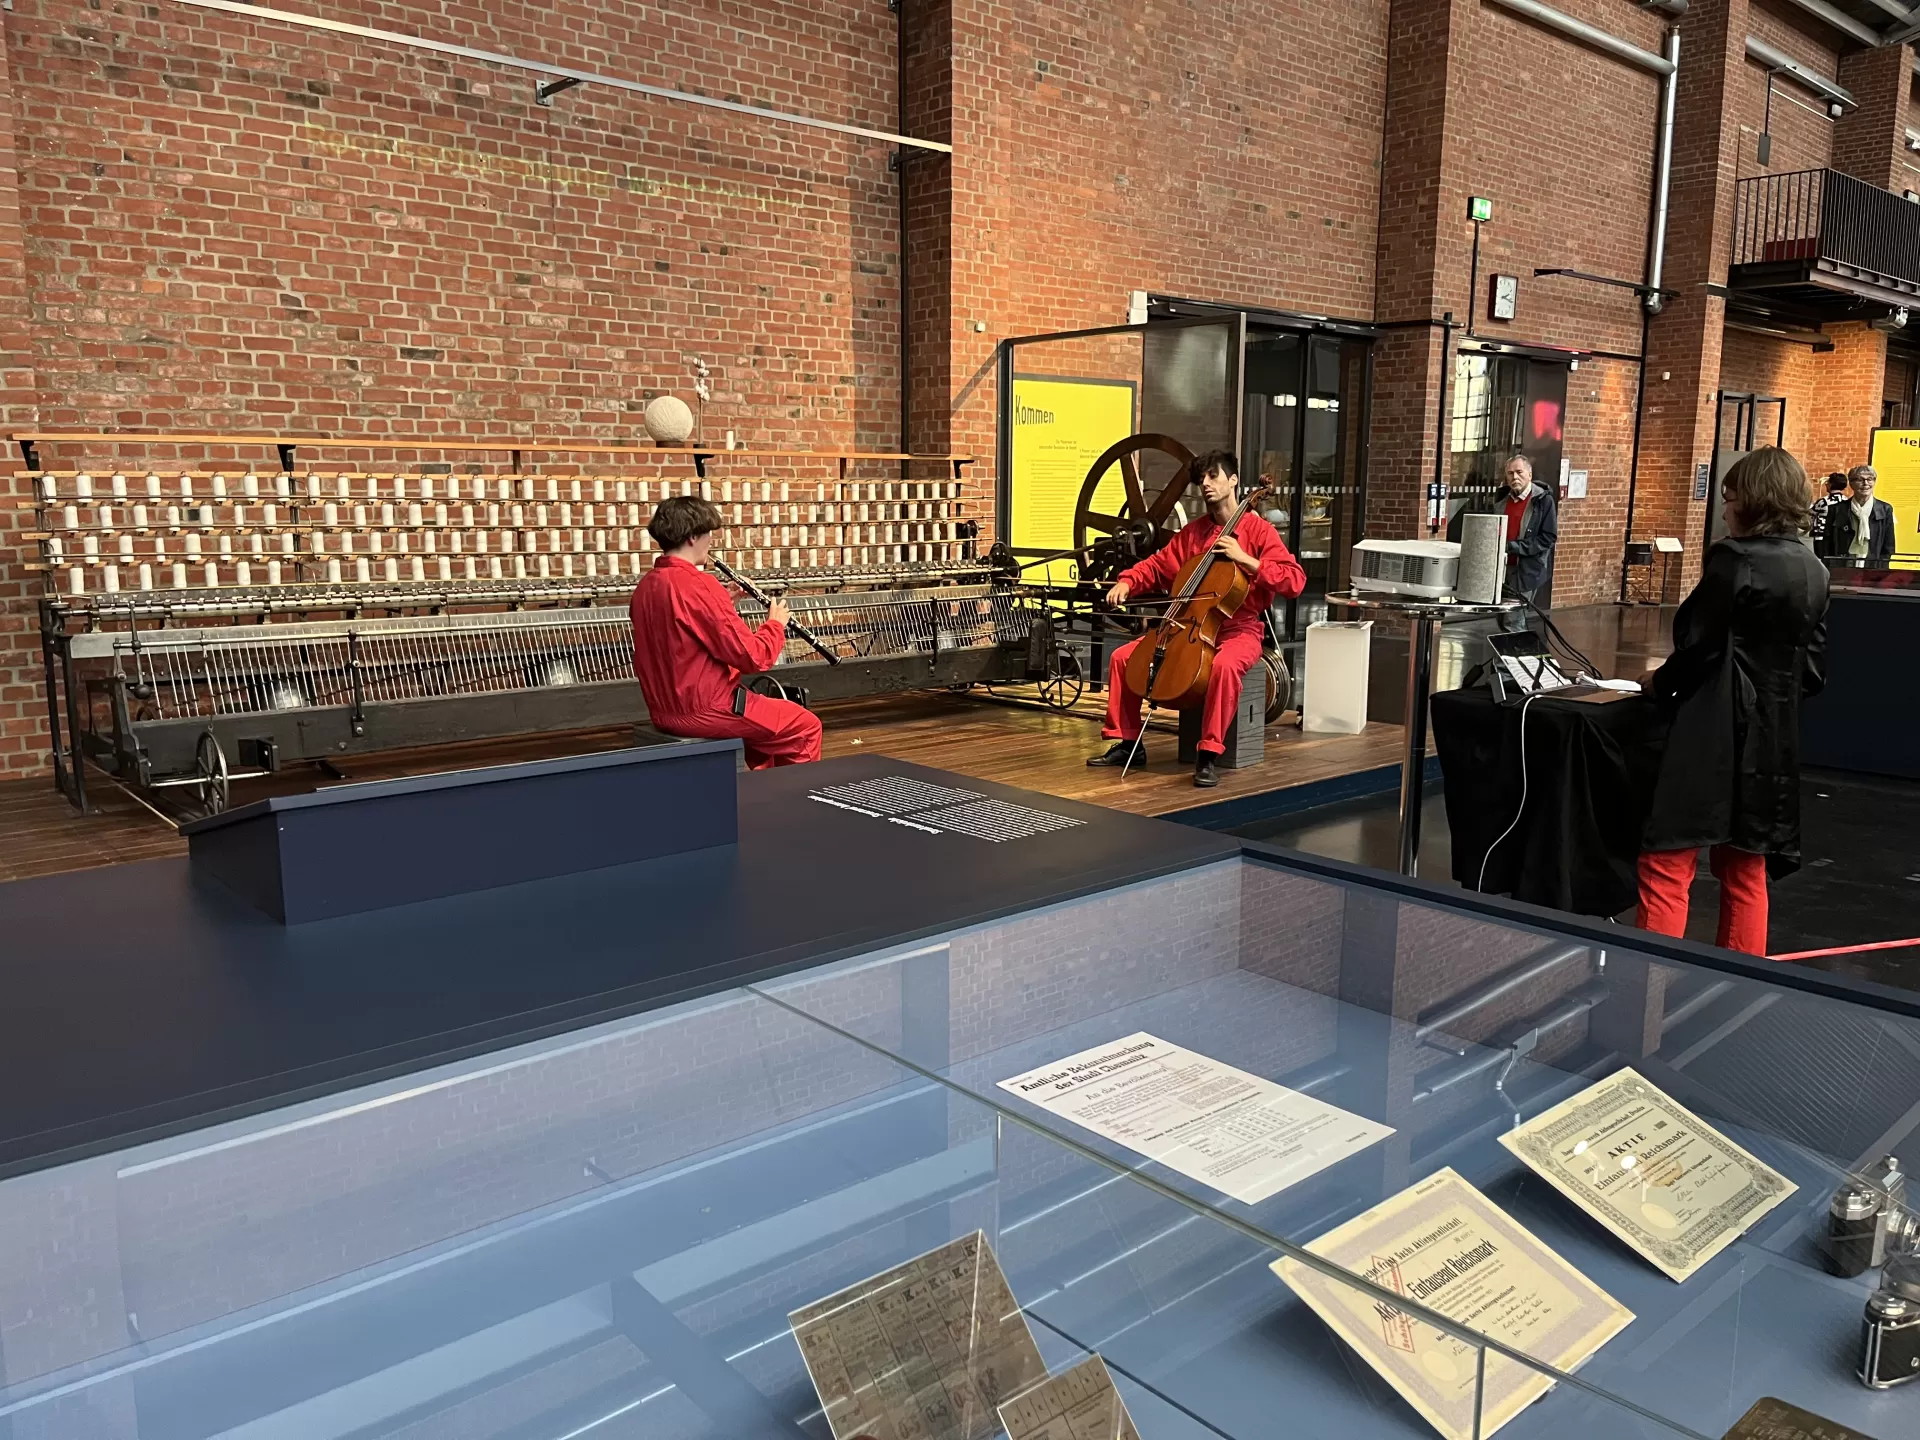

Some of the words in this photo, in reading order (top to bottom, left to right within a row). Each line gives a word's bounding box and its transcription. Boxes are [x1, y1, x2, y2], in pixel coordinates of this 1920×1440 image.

[1015, 395, 1055, 426] Kommen
[1055, 1080, 1074, 1091] der
[1098, 1053, 1149, 1074] Chemnitz
[1607, 1132, 1647, 1160] AKTIE
[1639, 1129, 1688, 1161] Reichsmark
[1406, 1261, 1459, 1300] Eintausend
[1445, 1237, 1500, 1277] Reichsmark
